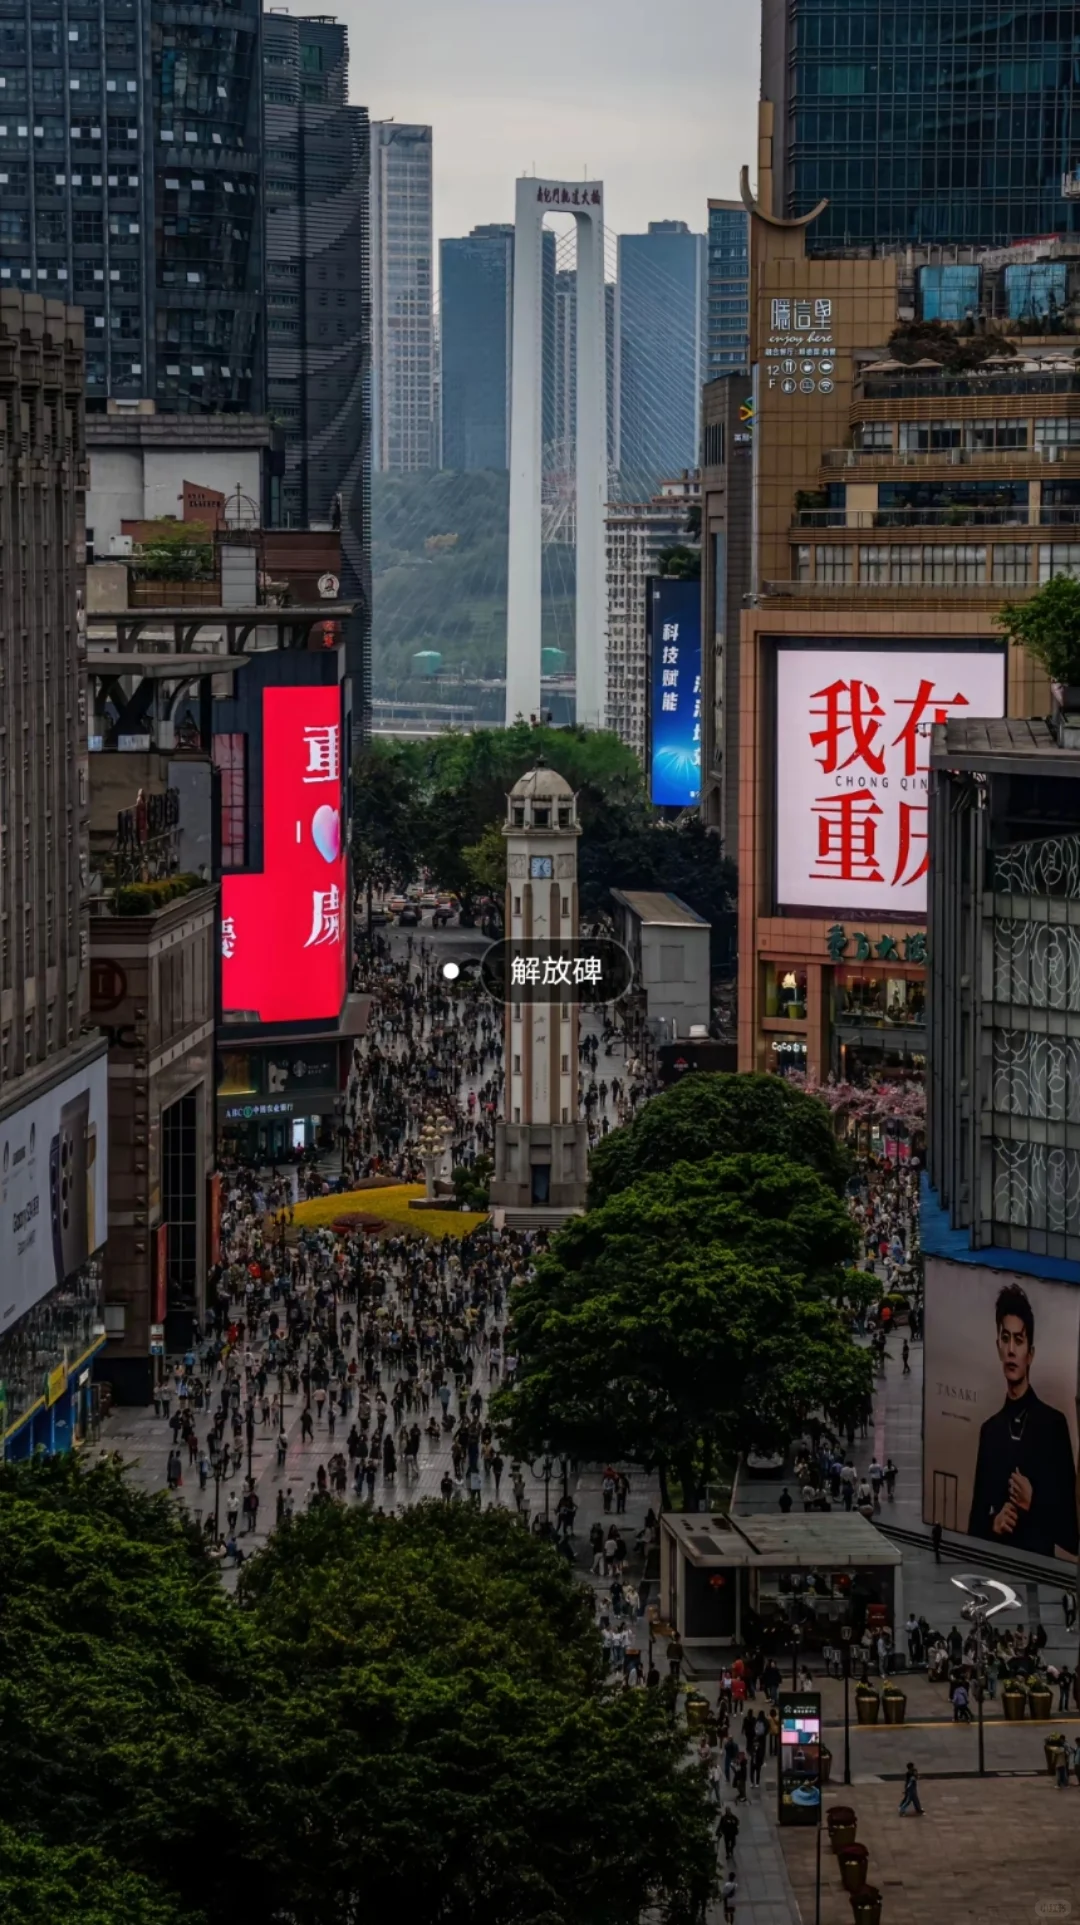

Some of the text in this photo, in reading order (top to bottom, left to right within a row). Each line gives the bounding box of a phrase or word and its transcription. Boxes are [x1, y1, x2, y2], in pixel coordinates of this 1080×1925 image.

[769, 330, 834, 347] enjoy here
[767, 365, 779, 375] 12
[769, 378, 776, 389] F
[661, 623, 680, 711] 科技赋能
[809, 679, 969, 776] 我在
[834, 775, 928, 791] CHONG QIN
[936, 1382, 977, 1403] TASAKI
